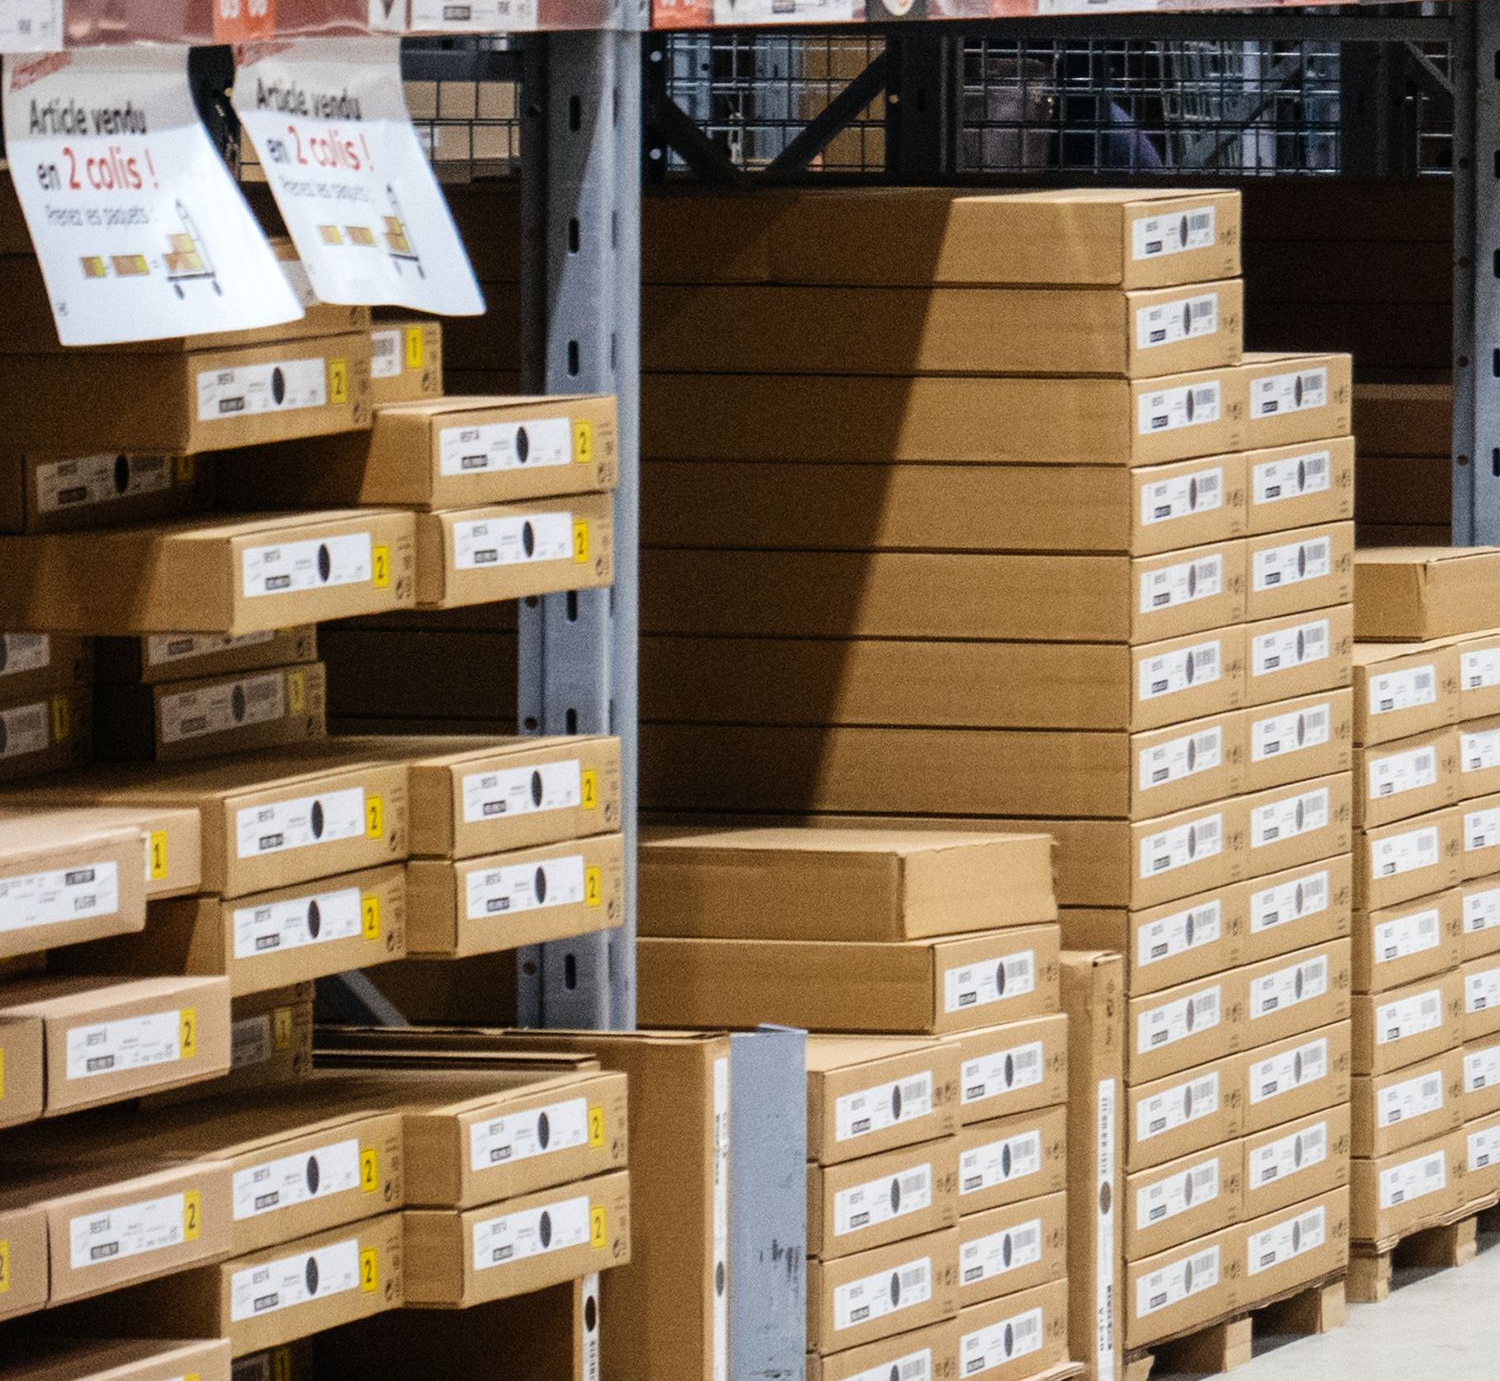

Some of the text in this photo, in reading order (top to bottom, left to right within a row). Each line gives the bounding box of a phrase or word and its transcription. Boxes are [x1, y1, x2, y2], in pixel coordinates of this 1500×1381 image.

[30, 99, 148, 136] Article vendu
[256, 77, 362, 121] Article vendu
[37, 145, 160, 191] en 2 colis !
[266, 139, 291, 165] en
[288, 125, 308, 165] 2
[309, 128, 362, 172] colis
